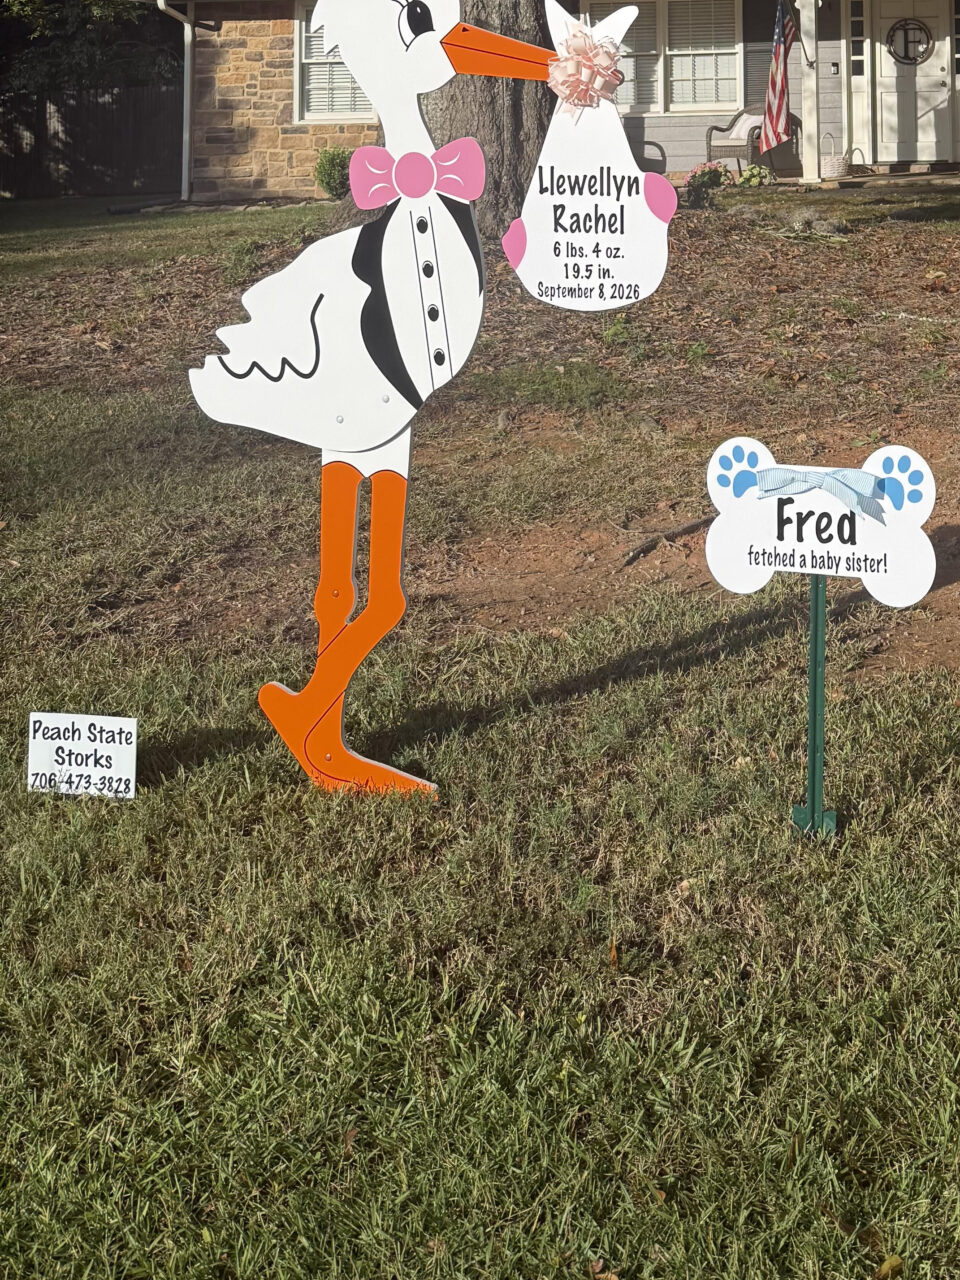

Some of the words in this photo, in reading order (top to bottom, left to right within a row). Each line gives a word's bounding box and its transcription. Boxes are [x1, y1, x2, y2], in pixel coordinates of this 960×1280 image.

[537, 165, 640, 202] Llewellyn
[553, 204, 625, 235] Rachel
[553, 241, 561, 258] 6
[566, 241, 588, 258] lbs.
[592, 241, 602, 259] 4
[605, 246, 625, 259] oz.
[564, 263, 594, 279] 19.5
[598, 264, 615, 279] in.
[537, 281, 595, 301] September
[598, 283, 607, 301] 8,
[610, 283, 640, 300] 2026
[747, 545, 796, 568] fetched
[799, 553, 807, 569] a
[810, 549, 842, 575] baby
[845, 551, 888, 574] sister!
[32, 719, 82, 742] Peach
[87, 722, 133, 746] State
[54, 745, 113, 770] Storks
[31, 772, 131, 795] 706-473-3828
